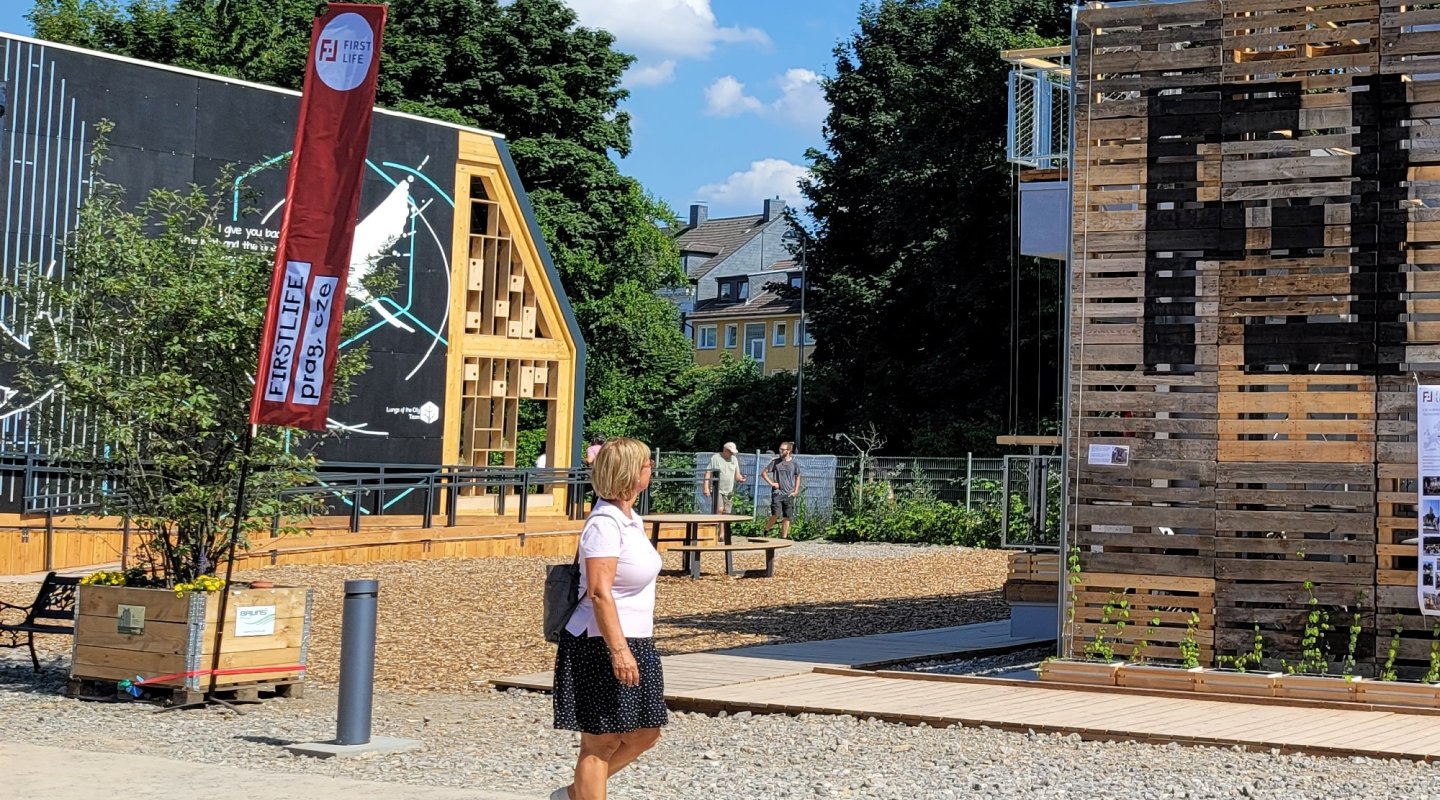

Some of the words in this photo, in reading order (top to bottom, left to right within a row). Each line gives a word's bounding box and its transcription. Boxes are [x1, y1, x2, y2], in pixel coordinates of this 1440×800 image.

[343, 40, 372, 51] FIRST
[342, 53, 364, 64] LIFE
[224, 225, 242, 237] give
[245, 228, 263, 239] you
[314, 283, 332, 328] cze
[269, 276, 304, 395] FIRSTLIFE
